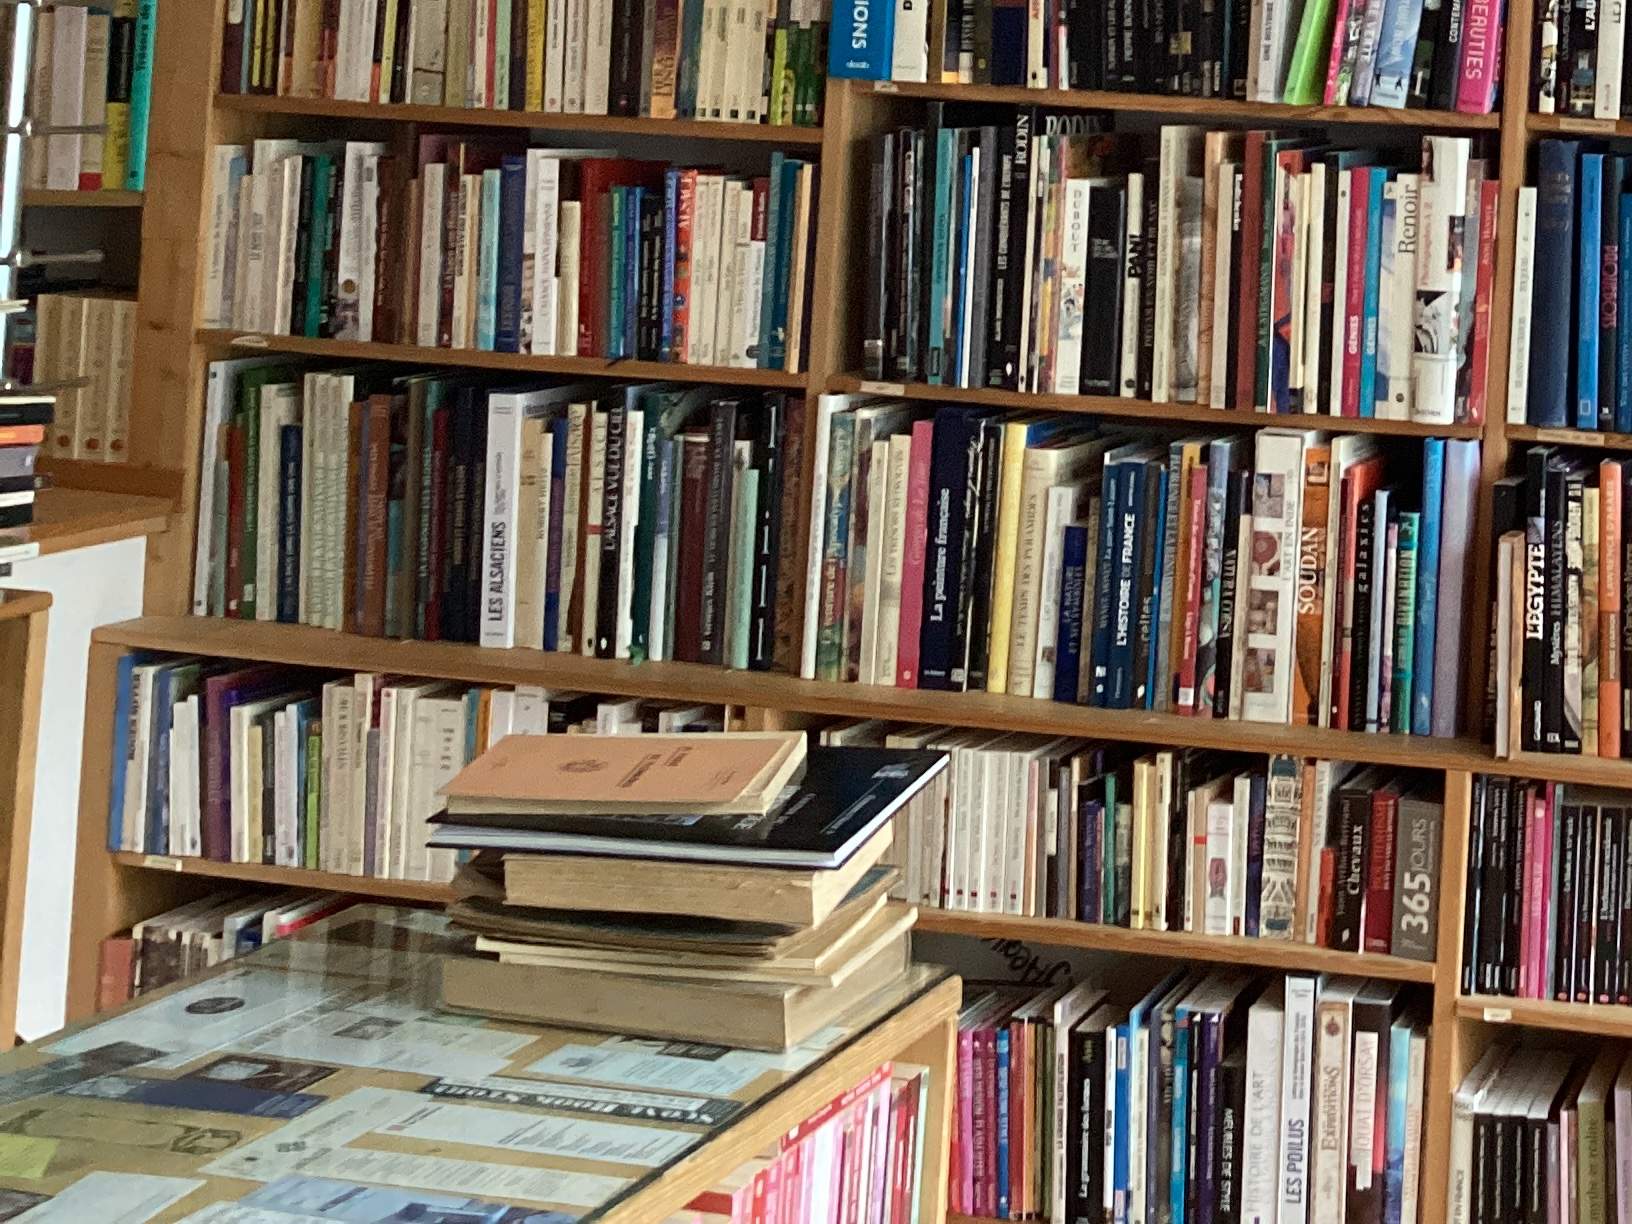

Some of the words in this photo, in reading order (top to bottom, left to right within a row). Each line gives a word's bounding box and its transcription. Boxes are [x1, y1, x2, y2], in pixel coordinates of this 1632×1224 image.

[1015, 114, 1029, 165] RODIN
[676, 174, 695, 231] ALSACE
[1071, 189, 1082, 252] DUBOUT
[1397, 184, 1419, 254] Renoir
[1347, 315, 1360, 354] GÉNIES
[1365, 316, 1377, 355] GÉNIES
[610, 407, 623, 434] CIEL
[608, 436, 620, 460] DU
[607, 461, 620, 489] VUE
[603, 491, 617, 550] L'ALSACE
[935, 487, 951, 544] française
[1284, 500, 1295, 528] INDE
[1606, 479, 1616, 532] D'ARABIE
[489, 521, 506, 593] ALSACIENS
[1120, 513, 1136, 564] FRANCE
[1283, 531, 1294, 547] EN
[1356, 502, 1370, 594] galaxies
[932, 546, 948, 600] peinture
[1280, 551, 1293, 581] L'ART
[1297, 526, 1320, 616] SOUDAN
[1606, 535, 1615, 597] LAWRENCE
[487, 596, 503, 622] LES
[929, 604, 944, 621] La
[1116, 579, 1132, 646] L'HISTOIRE
[1139, 596, 1152, 642] celtes
[1348, 824, 1363, 895] Chevaux
[1410, 818, 1427, 871] JOURS
[1401, 871, 1430, 934] 365
[1222, 1107, 1234, 1160] MEUBLES
[1249, 1116, 1267, 1139] DE
[1285, 1118, 1306, 1174] POILUS
[1219, 1179, 1232, 1212] STYLE
[1244, 1143, 1270, 1213] HISTOIRE
[1285, 1177, 1303, 1204] LES
